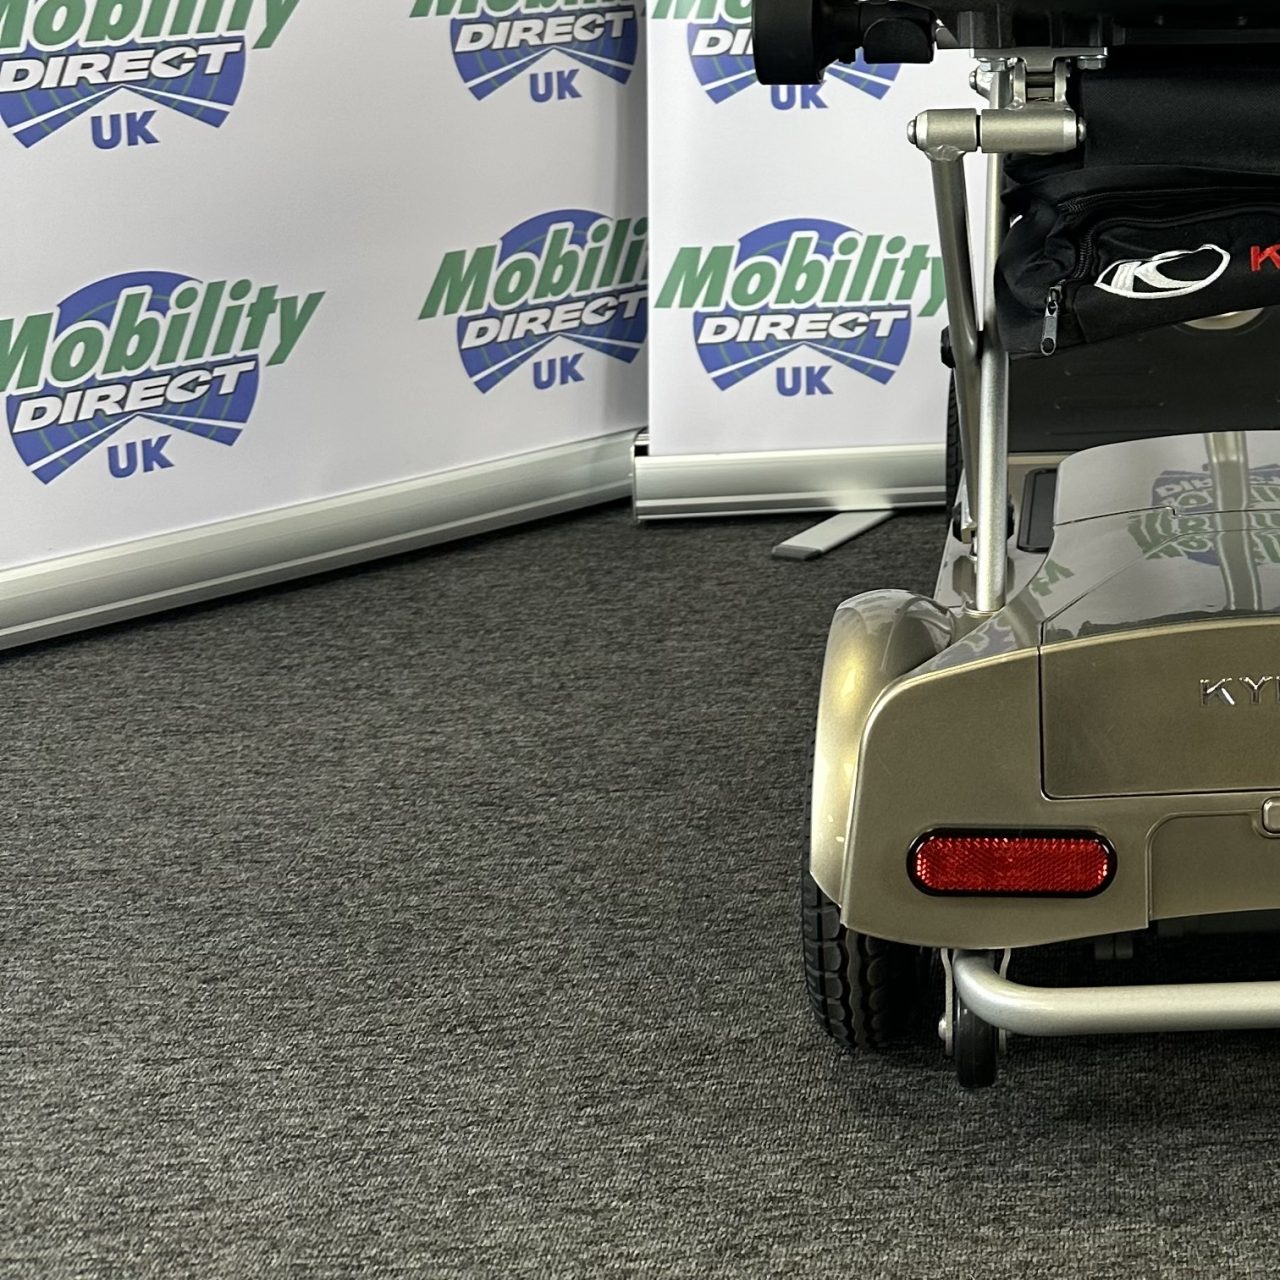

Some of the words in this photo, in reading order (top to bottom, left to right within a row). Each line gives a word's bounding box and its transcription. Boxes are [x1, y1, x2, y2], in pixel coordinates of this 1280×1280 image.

[454, 11, 634, 52] DIRECT
[0, 42, 242, 92] DIRECT
[529, 69, 582, 103] UK
[91, 110, 159, 150] UK
[418, 217, 648, 320] Mobili
[0, 279, 325, 392] Mobility
[461, 291, 648, 349] DIRECT
[698, 310, 908, 344] DIRECT
[533, 352, 585, 390] UK
[776, 365, 833, 397] UK
[12, 361, 256, 433] DIRECT
[107, 434, 174, 478] UK
